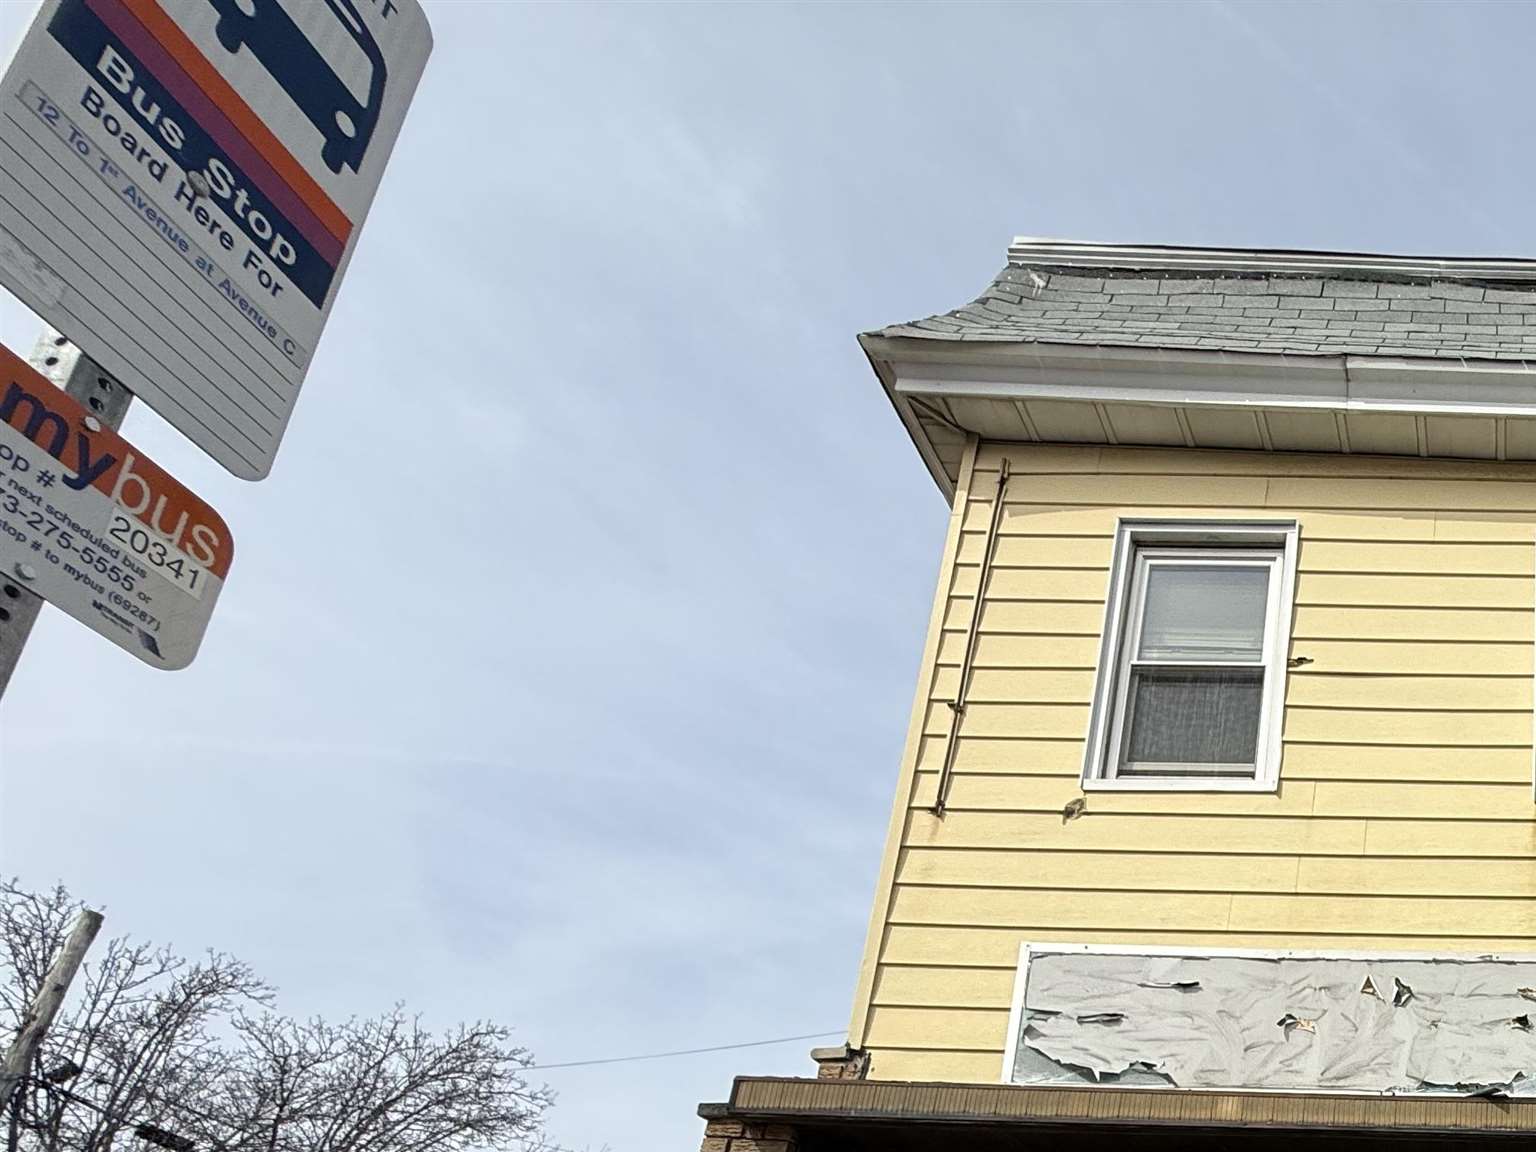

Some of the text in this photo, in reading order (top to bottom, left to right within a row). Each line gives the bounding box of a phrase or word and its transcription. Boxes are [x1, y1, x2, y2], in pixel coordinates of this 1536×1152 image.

[36, 96, 60, 126] 12
[68, 124, 90, 155] To
[122, 185, 190, 252] Avenue
[194, 255, 215, 278] at
[218, 278, 278, 338] Avenue
[283, 338, 297, 356] C
[80, 85, 284, 297] Board Here For
[96, 44, 297, 267] Bus Stop
[0, 443, 30, 473] op
[109, 515, 200, 590] 20341
[0, 487, 136, 592] 3-275-5555
[0, 520, 27, 543] top
[45, 549, 60, 565] to
[63, 562, 105, 595] mybus
[108, 591, 161, 632] (69287)
[7, 478, 148, 579] next scheduled bus
